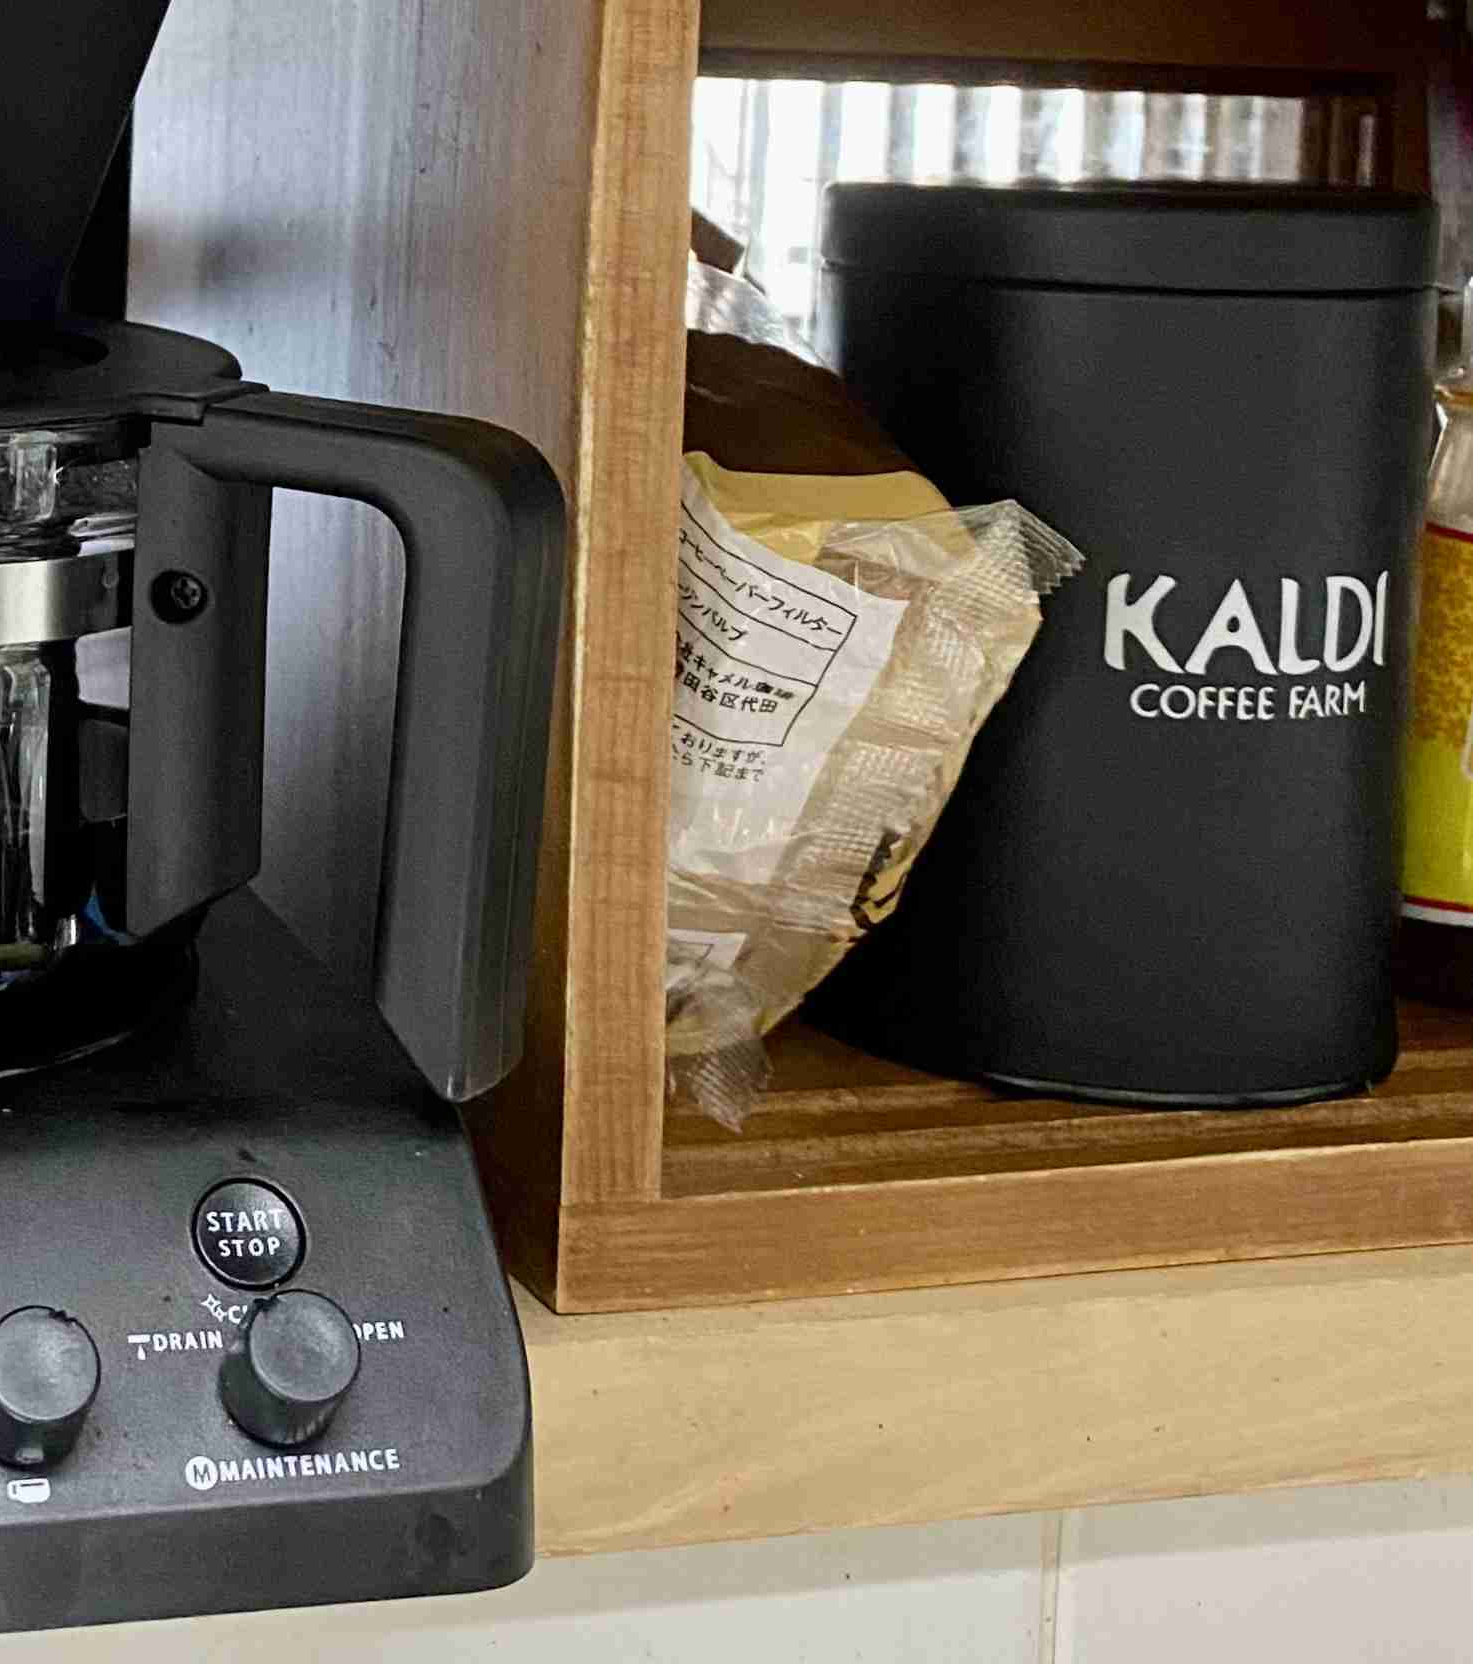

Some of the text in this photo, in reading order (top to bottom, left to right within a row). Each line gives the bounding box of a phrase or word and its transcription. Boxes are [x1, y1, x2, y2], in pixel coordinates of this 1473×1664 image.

[1104, 570, 1389, 676] KALDI
[1130, 681, 1366, 720] COFFEE FARM
[207, 1209, 284, 1233] START
[218, 1236, 281, 1257] STOP
[152, 1330, 224, 1352] DRAIN
[219, 1448, 400, 1482] MAINTENANCE
